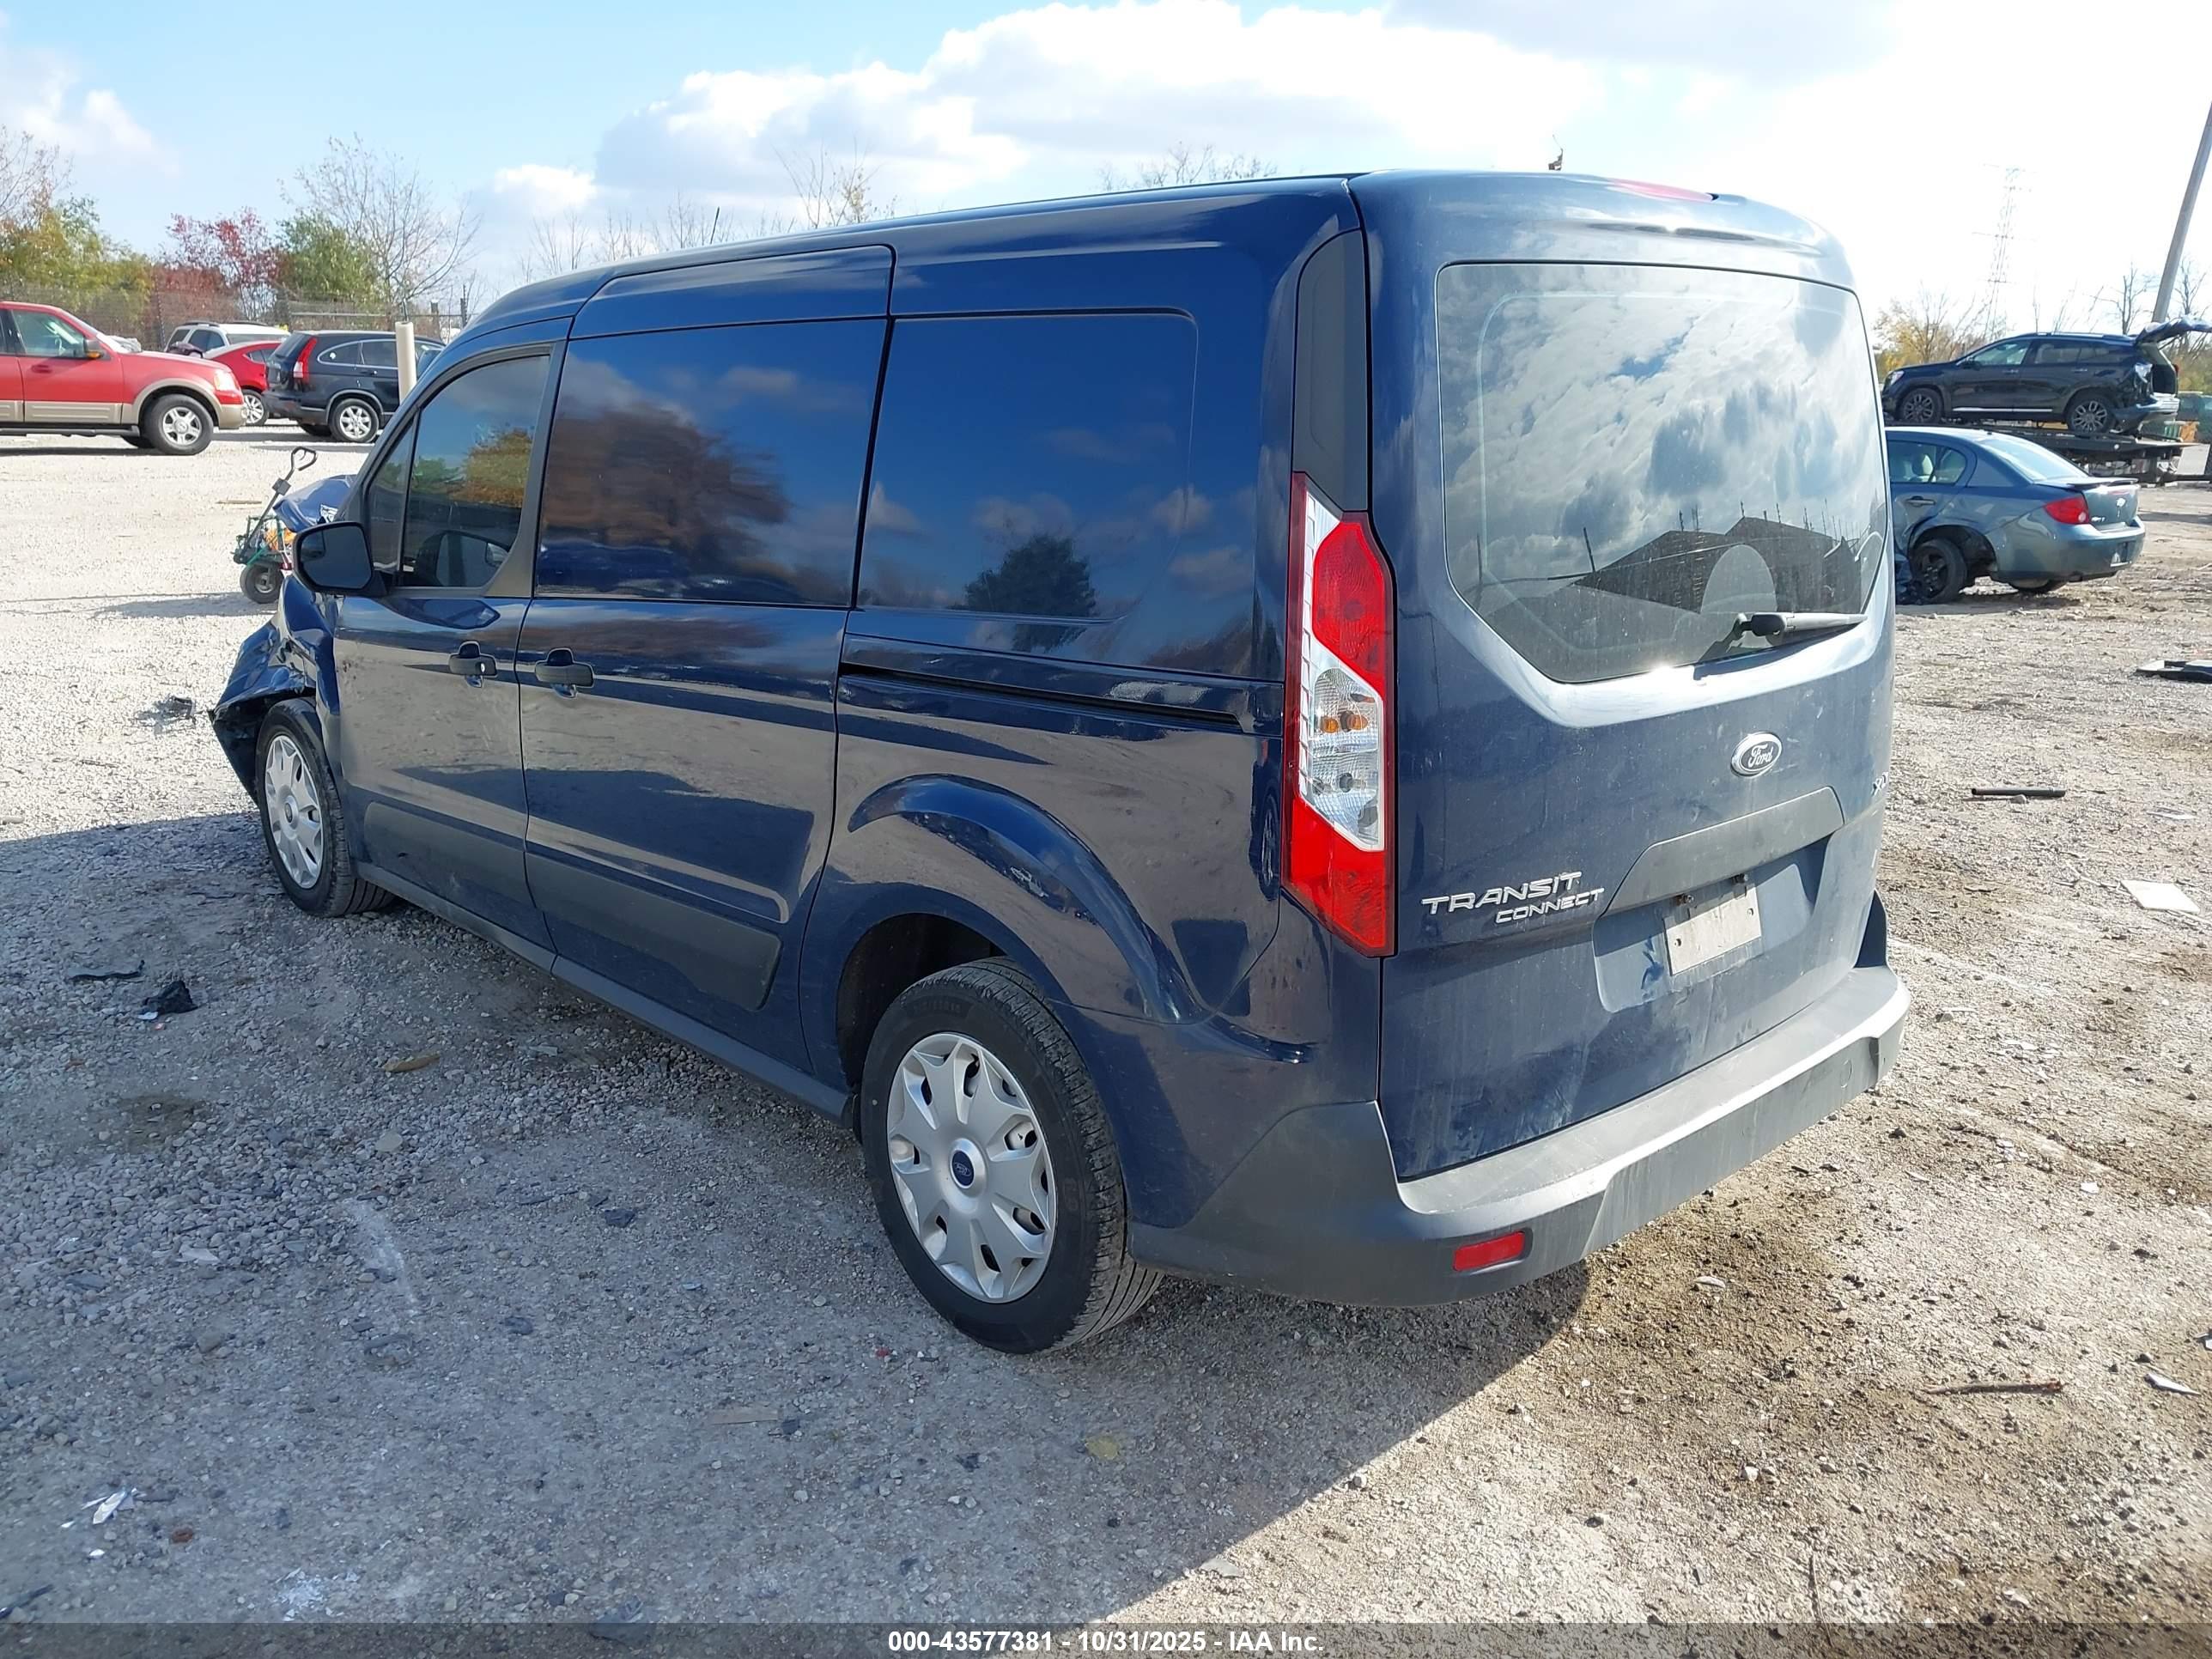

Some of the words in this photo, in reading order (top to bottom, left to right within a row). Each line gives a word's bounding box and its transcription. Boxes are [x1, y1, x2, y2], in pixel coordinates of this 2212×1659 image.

[1747, 744, 1774, 768] Ford
[1421, 872, 1583, 915] TRANSIT
[1495, 887, 1605, 924] CONNECT
